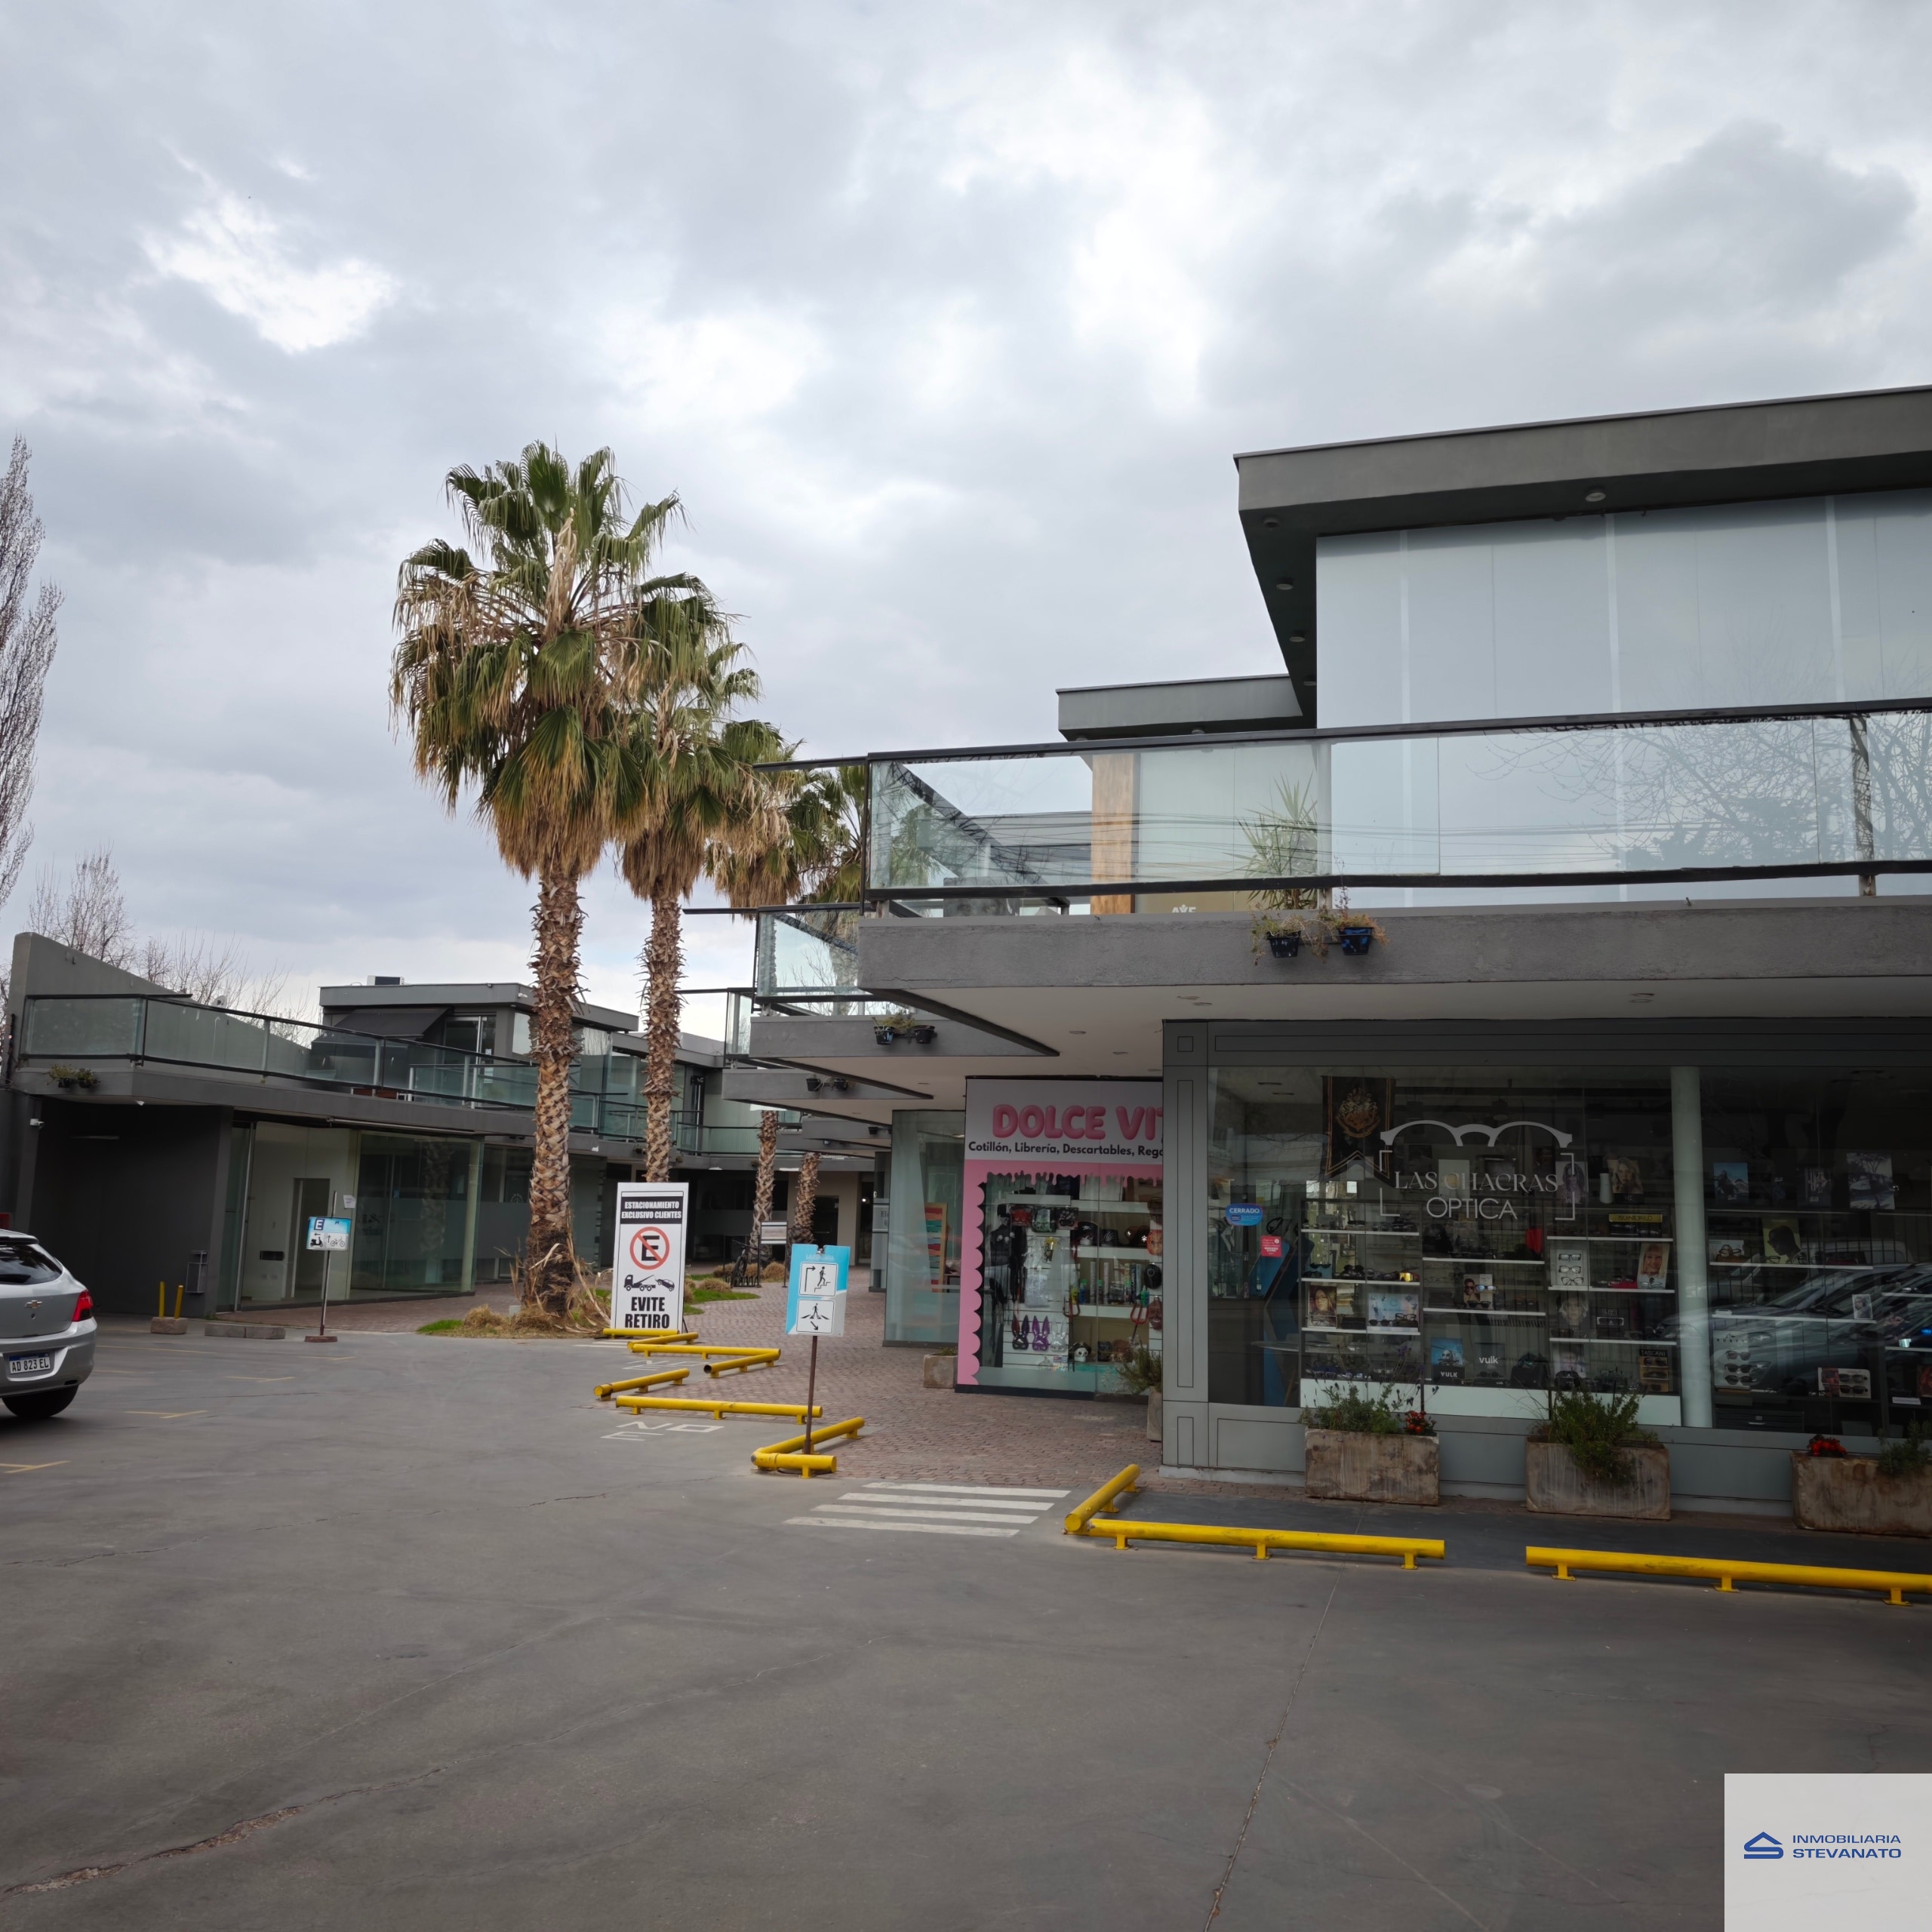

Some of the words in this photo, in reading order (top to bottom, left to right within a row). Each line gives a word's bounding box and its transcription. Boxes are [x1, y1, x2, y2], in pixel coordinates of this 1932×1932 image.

[992, 1104, 1106, 1140] DOLCE
[968, 1141, 1011, 1154] Cotillón,
[1014, 1142, 1060, 1155] Librería,
[1063, 1143, 1134, 1157] Descartables,
[1395, 1171, 1437, 1189] LAS
[1444, 1173, 1558, 1193] CHACRAS
[654, 1211, 682, 1219] CLIENTES
[1426, 1197, 1518, 1220] OPTICA
[315, 1220, 323, 1230] E
[631, 1297, 665, 1312] EVITE
[625, 1313, 670, 1328] RETIRO
[12, 1361, 21, 1372] AD
[23, 1359, 38, 1371] 823
[1479, 1355, 1499, 1364] vulk
[616, 1421, 725, 1433] NO
